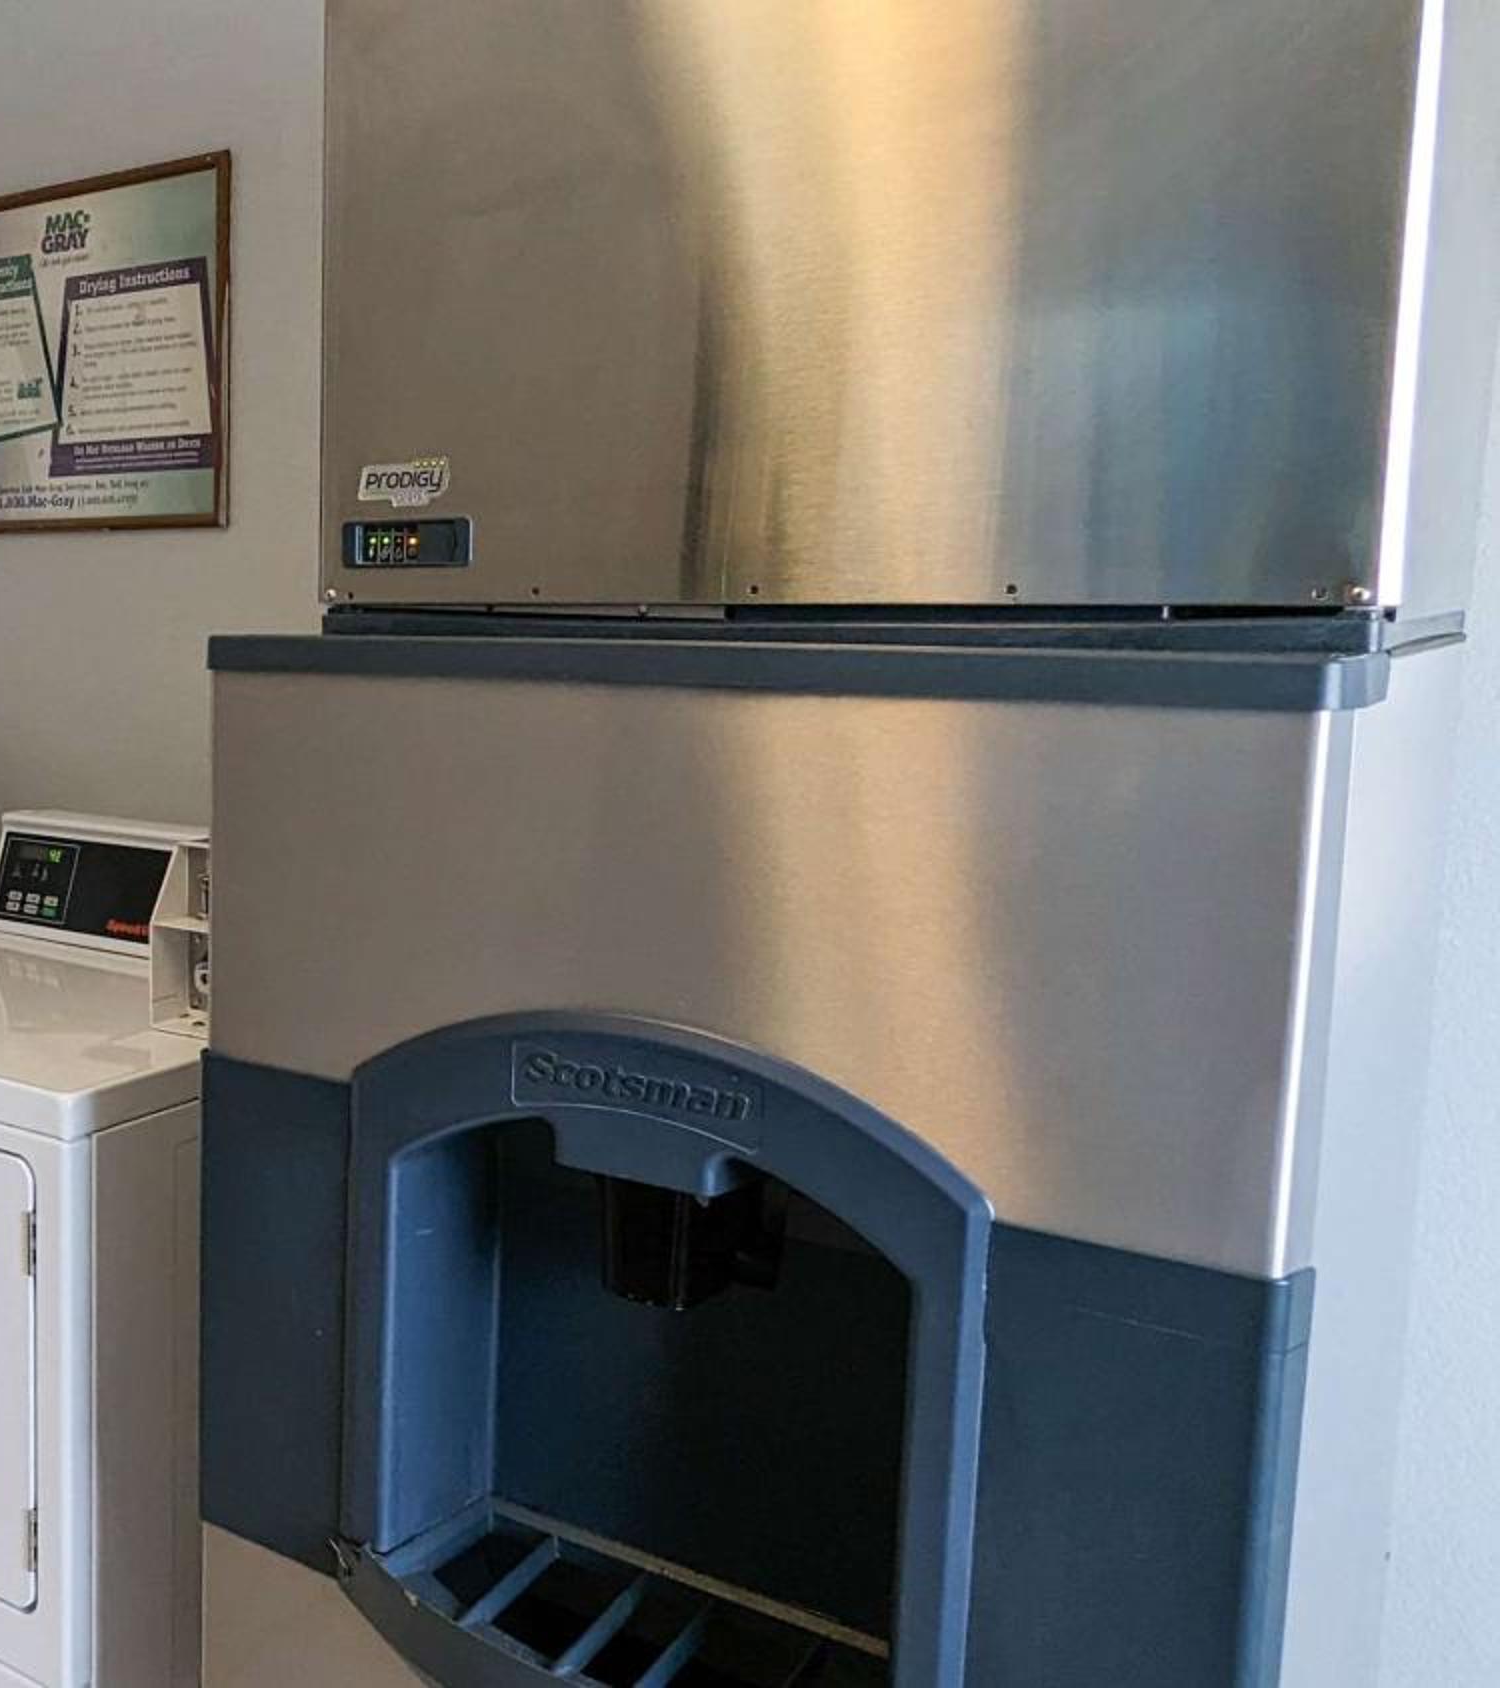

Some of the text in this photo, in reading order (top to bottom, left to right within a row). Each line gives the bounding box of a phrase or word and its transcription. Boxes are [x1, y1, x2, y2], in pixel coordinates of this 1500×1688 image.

[41, 228, 90, 255] GRAY
[79, 266, 192, 297] Drying Instructions
[522, 1050, 752, 1121] Scotsman
